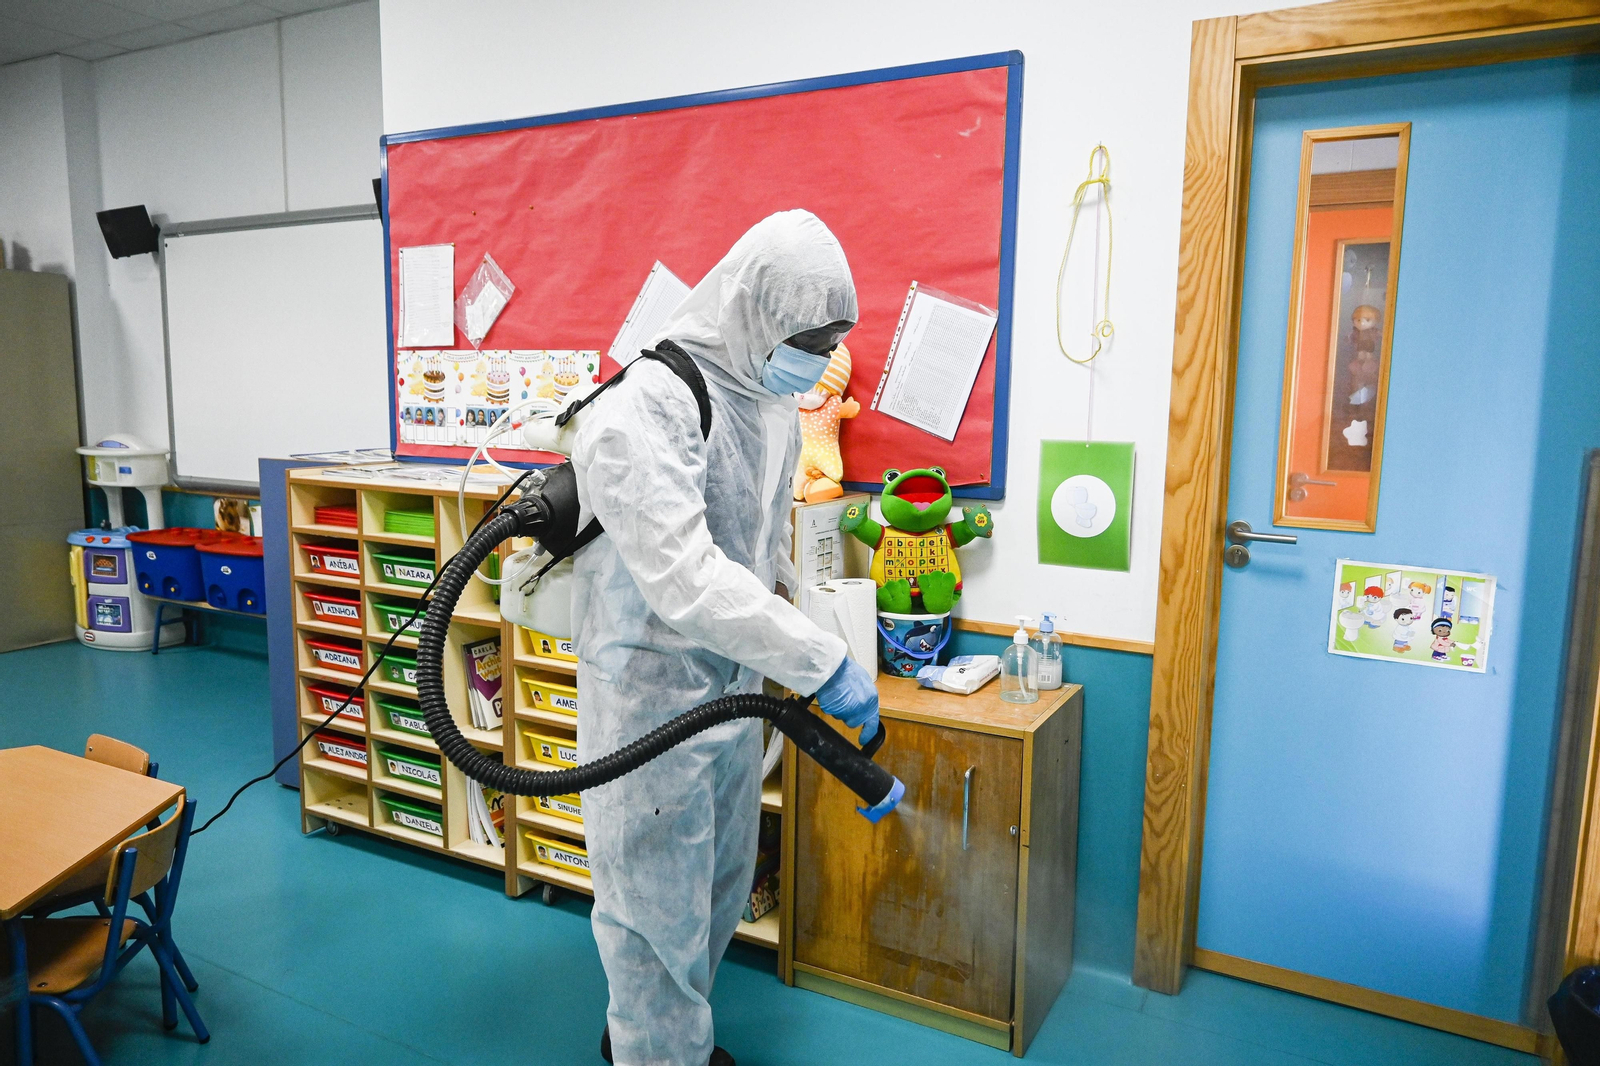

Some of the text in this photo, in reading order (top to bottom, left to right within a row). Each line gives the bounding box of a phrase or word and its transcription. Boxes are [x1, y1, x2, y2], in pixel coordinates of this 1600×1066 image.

[897, 538, 903, 547] b
[919, 539, 925, 547] d
[939, 537, 944, 545] f
[897, 549, 904, 557] h
[329, 559, 357, 571] ANÍBAL
[919, 559, 926, 567] p
[929, 558, 936, 566] q
[398, 567, 432, 580] NAIARA
[898, 569, 903, 577] t
[327, 605, 357, 617] AINHOA
[473, 645, 493, 656] CARLA
[560, 642, 573, 653] CE
[324, 652, 358, 666] ADRIANA
[404, 718, 429, 732] PABLO
[328, 745, 368, 762] ALEJANDRO
[560, 750, 578, 762] LUC
[401, 764, 438, 782] NICOLÁS
[557, 803, 581, 816] SINUHE
[405, 813, 441, 833] DANIELA
